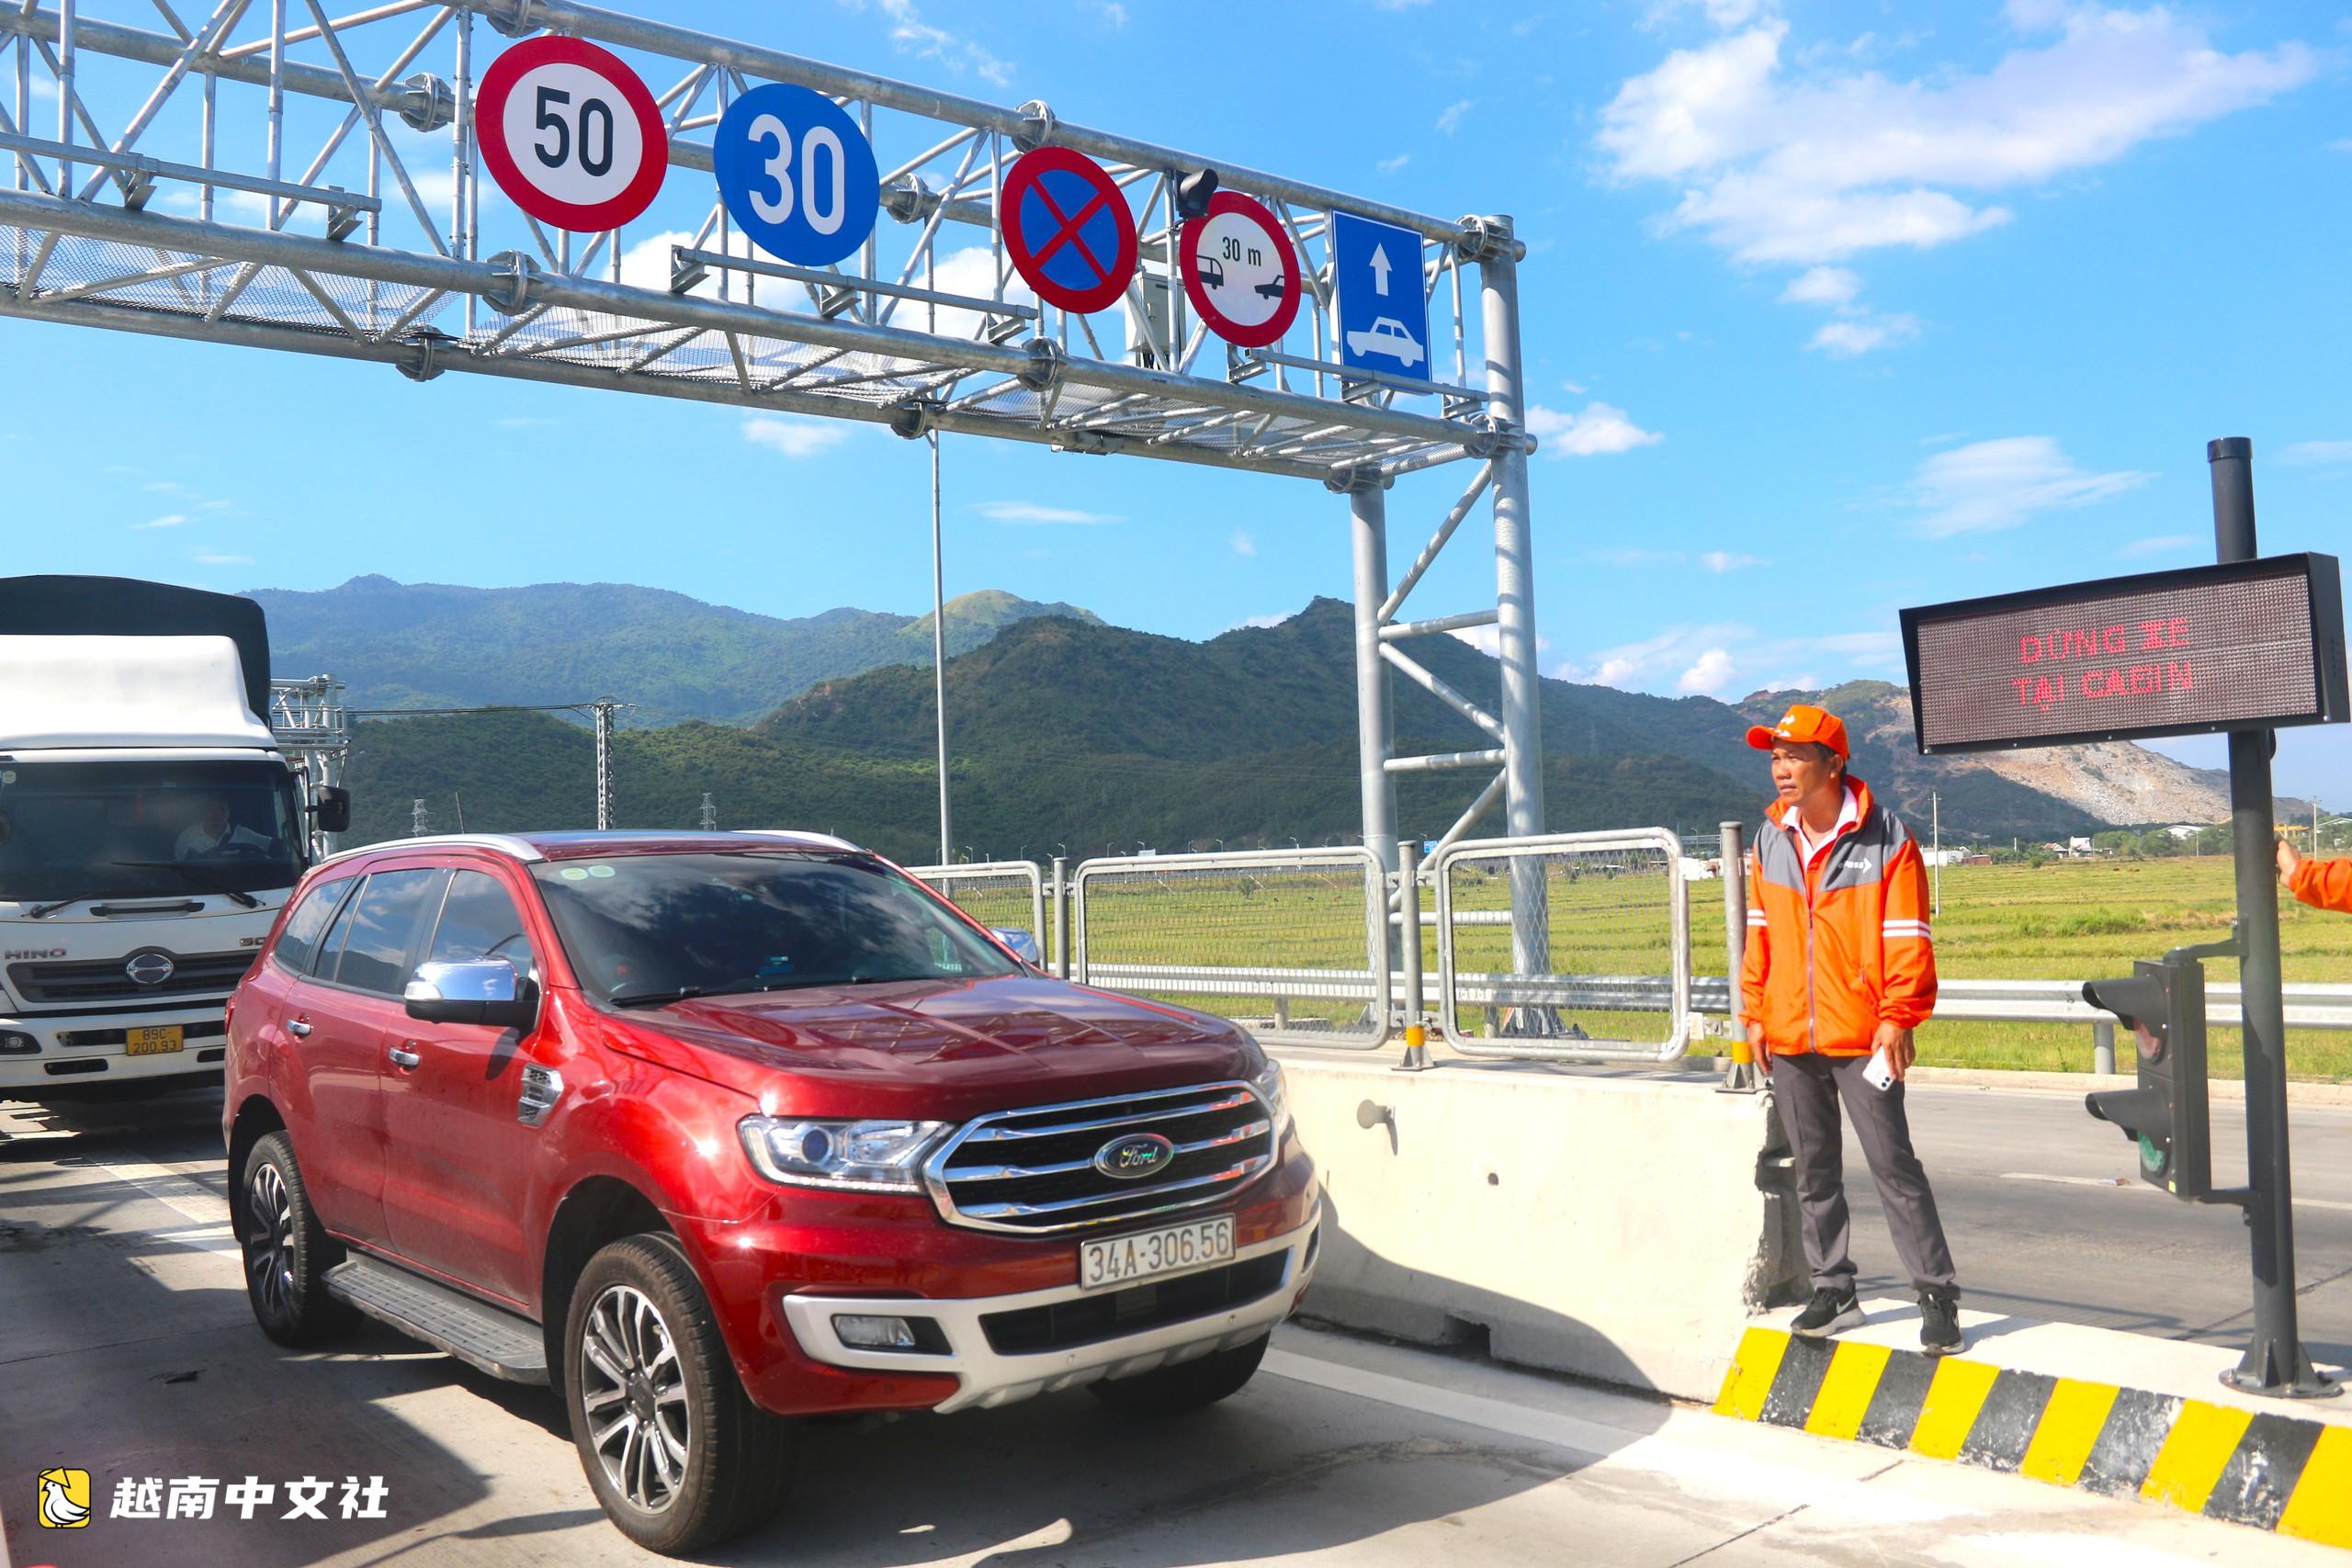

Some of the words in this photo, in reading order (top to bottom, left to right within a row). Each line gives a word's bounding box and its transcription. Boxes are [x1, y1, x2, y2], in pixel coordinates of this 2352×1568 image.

[534, 85, 614, 177] 50
[748, 114, 844, 235] 30
[1222, 236, 1240, 262] 30
[1248, 248, 1261, 266] m
[2010, 673, 2064, 712] TẠI
[5, 947, 67, 960] HINO
[1118, 1143, 1159, 1168] Ford
[1089, 1222, 1229, 1282] 34A-306.56
